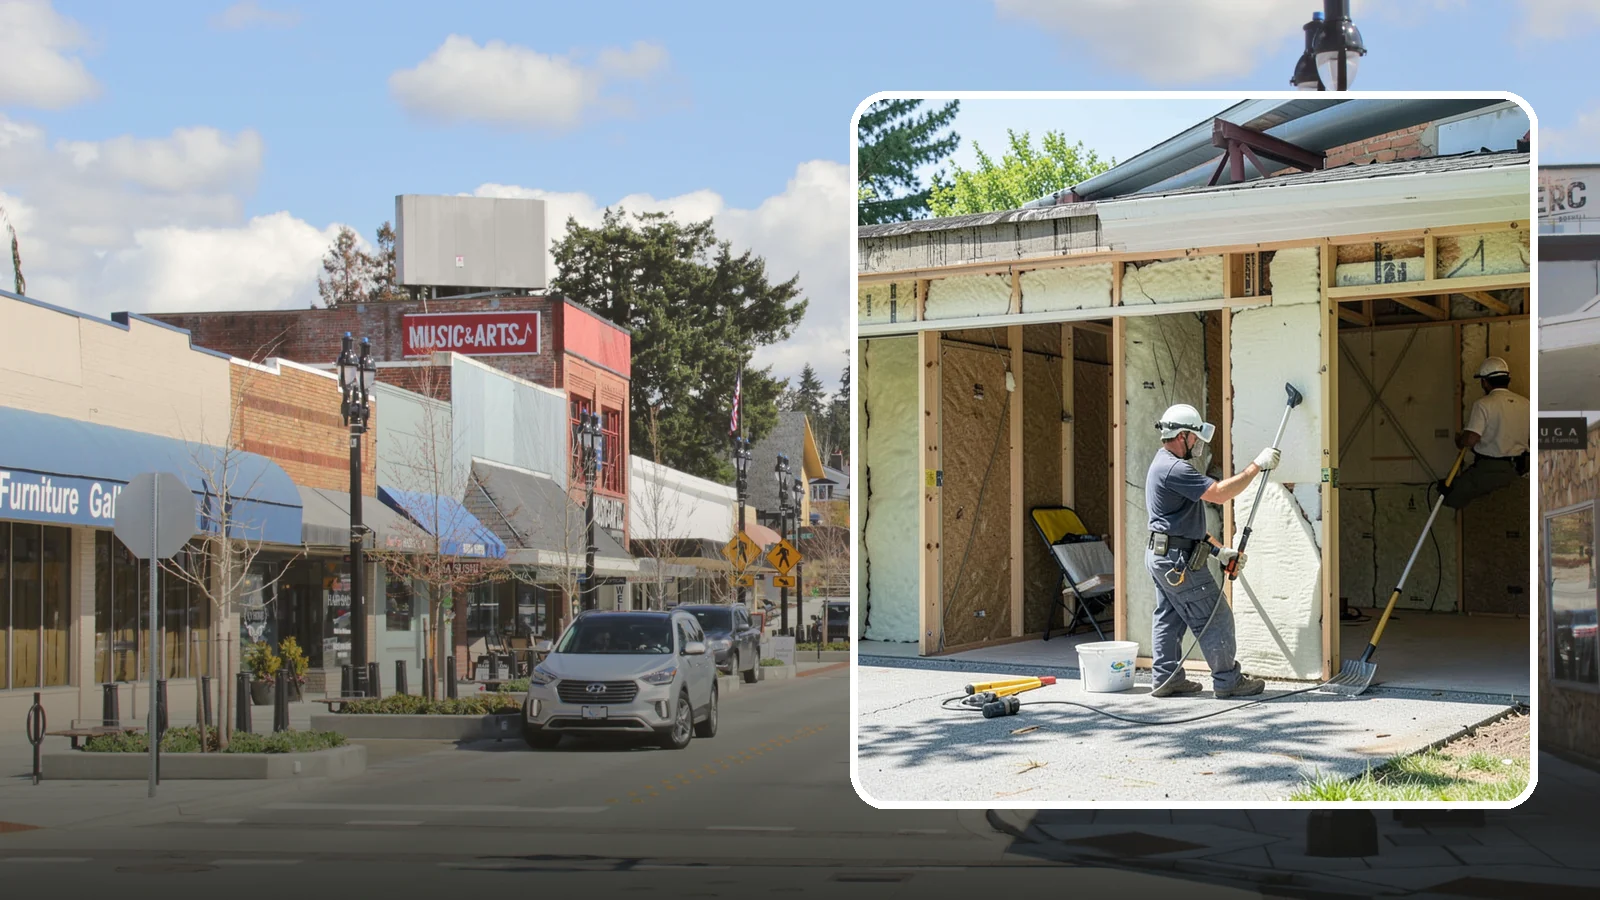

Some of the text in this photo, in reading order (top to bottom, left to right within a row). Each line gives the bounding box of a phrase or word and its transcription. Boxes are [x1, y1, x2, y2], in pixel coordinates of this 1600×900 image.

[409, 323, 519, 349] MUSIC&ARTS
[0, 471, 79, 516] Furniture
[454, 562, 479, 574] SUSHI
